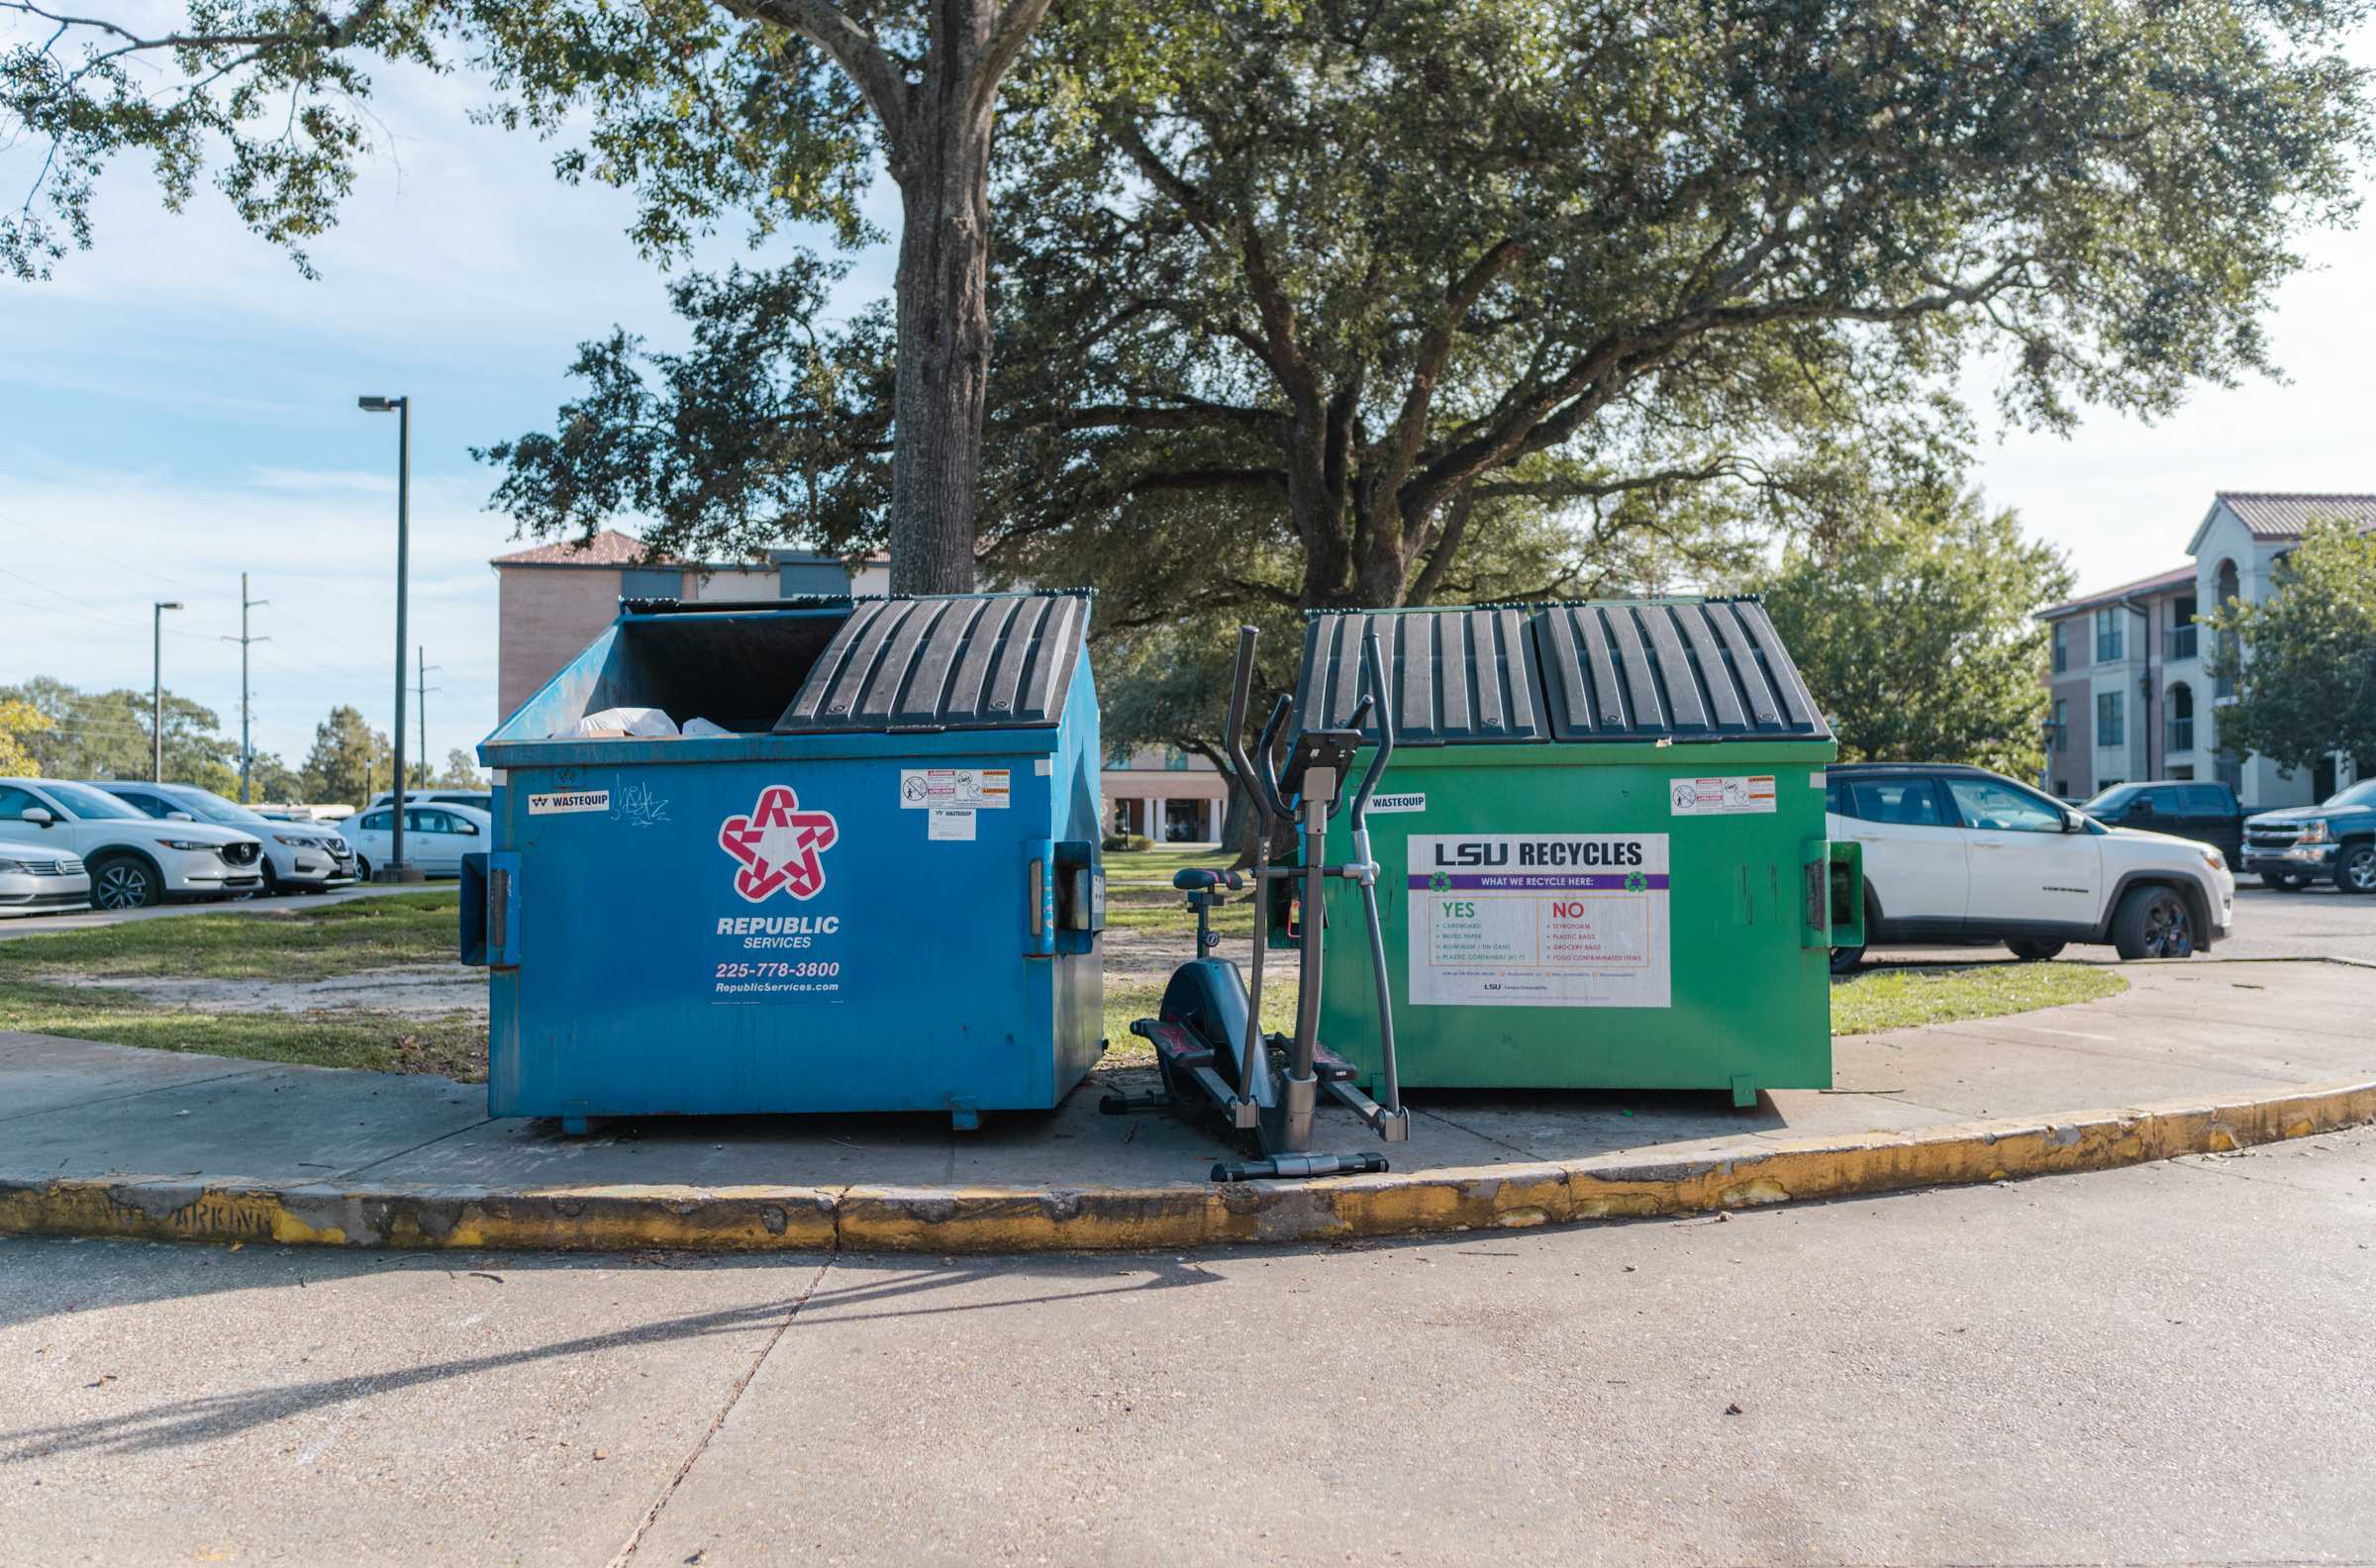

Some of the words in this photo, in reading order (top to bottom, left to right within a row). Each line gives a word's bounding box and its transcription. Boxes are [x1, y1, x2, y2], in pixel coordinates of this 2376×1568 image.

[552, 795, 608, 807] WASTEQUIP
[1373, 797, 1425, 807] WASTEQUIP
[1436, 843, 1508, 866] LSU
[1520, 841, 1642, 865] RECYCLES
[1481, 877, 1503, 886] WHAT
[1510, 877, 1524, 886] WE
[1527, 877, 1565, 886] RECYCLE
[1568, 877, 1594, 886] HERE:
[1442, 902, 1475, 918] YES
[1552, 902, 1584, 919] NO
[717, 916, 840, 935] REPUBLIC
[743, 936, 812, 948] SERVICES
[715, 962, 840, 978] 225-778-3800
[715, 982, 839, 994] RepublicServices.com
